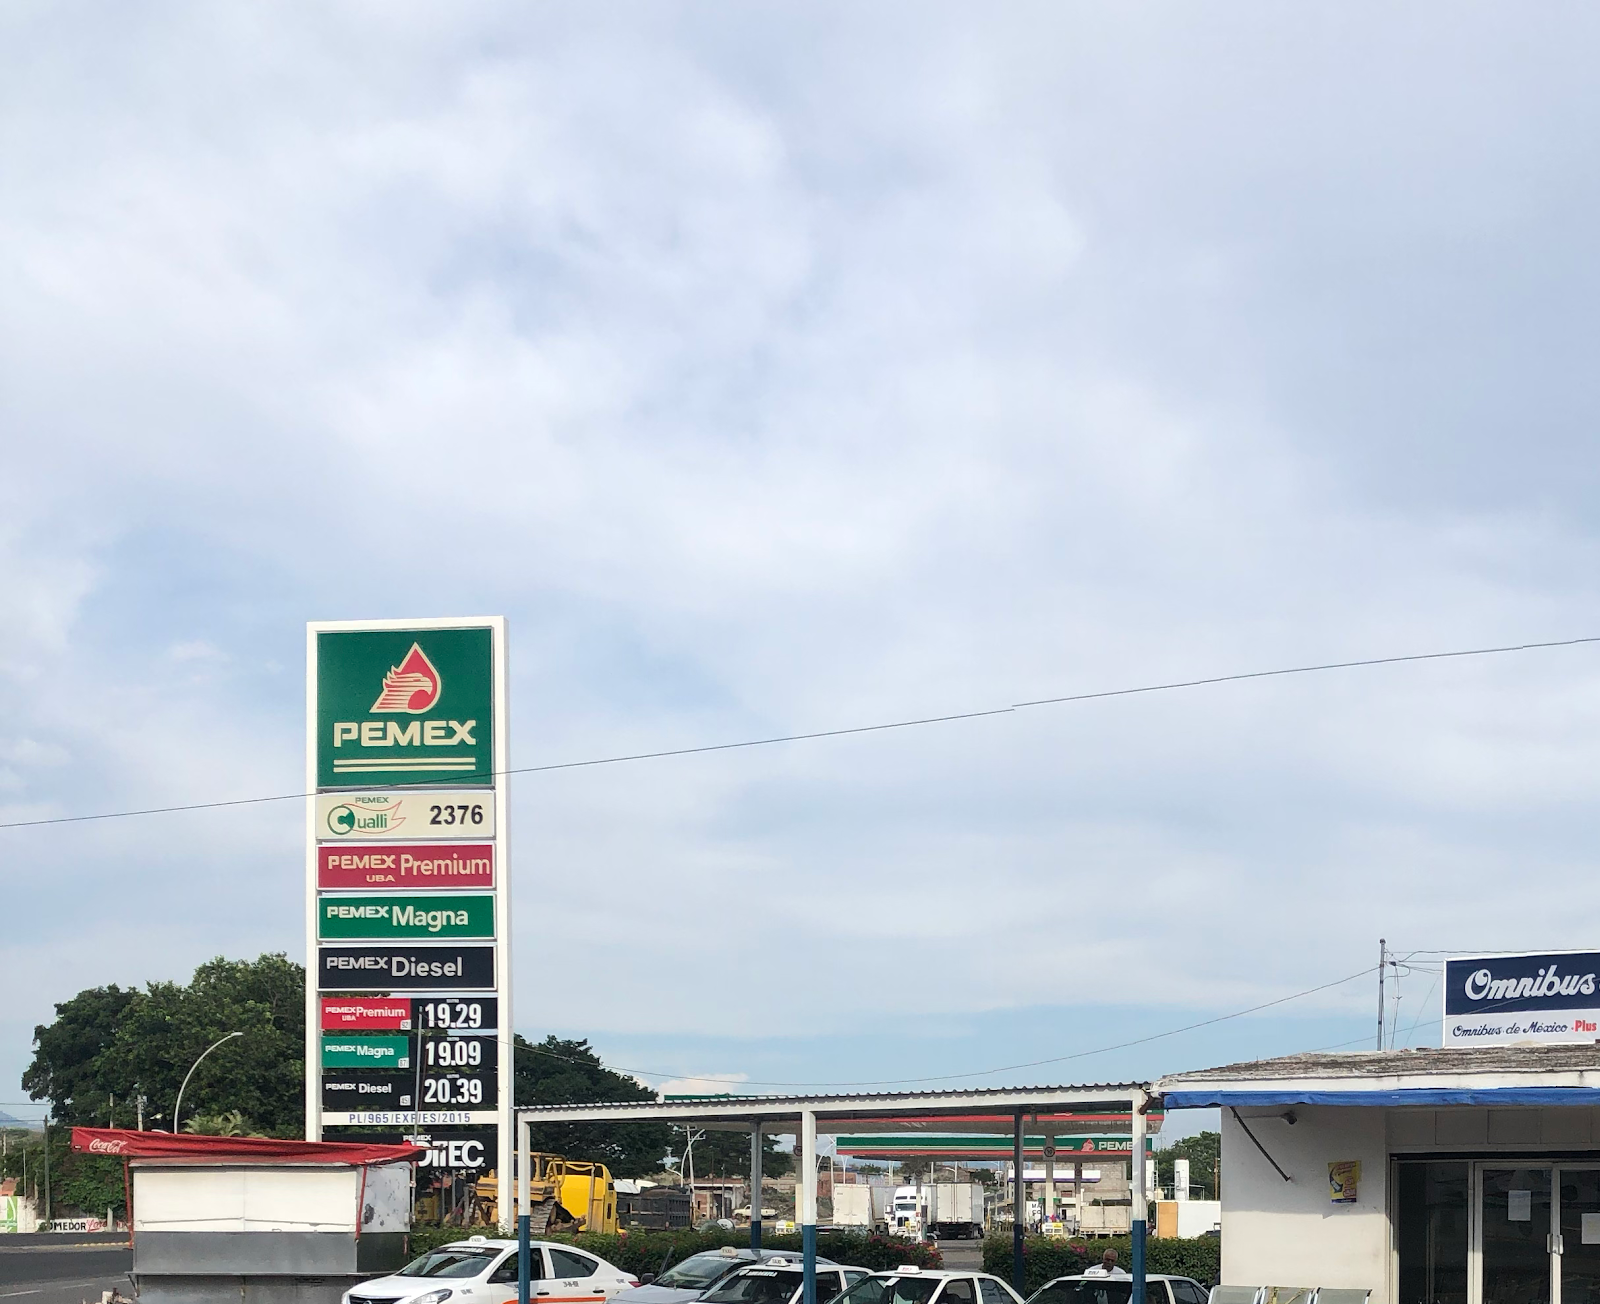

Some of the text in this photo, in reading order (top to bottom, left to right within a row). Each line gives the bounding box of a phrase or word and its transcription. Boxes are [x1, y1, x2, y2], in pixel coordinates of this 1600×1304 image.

[333, 720, 476, 747] PEMEX
[355, 796, 390, 804] PEMEX
[429, 804, 484, 825] 2376
[327, 854, 490, 876] PEMEX Premium
[366, 874, 396, 882] UBA
[326, 905, 469, 932] PEMEX Magna
[326, 956, 463, 977] PEMEX Diesel
[1464, 963, 1596, 1001] Omnibus
[325, 1006, 406, 1018] PEMEX Premium
[425, 1003, 482, 1028] 19.29
[1452, 1025, 1501, 1038] Omnibus
[1504, 1023, 1521, 1035] de
[1522, 1021, 1568, 1034] México
[356, 1045, 395, 1059] Magna
[425, 1041, 482, 1066] 19.09
[358, 1083, 392, 1093] Diesel
[424, 1079, 483, 1104] 20.39
[1098, 1141, 1134, 1151] PEME
